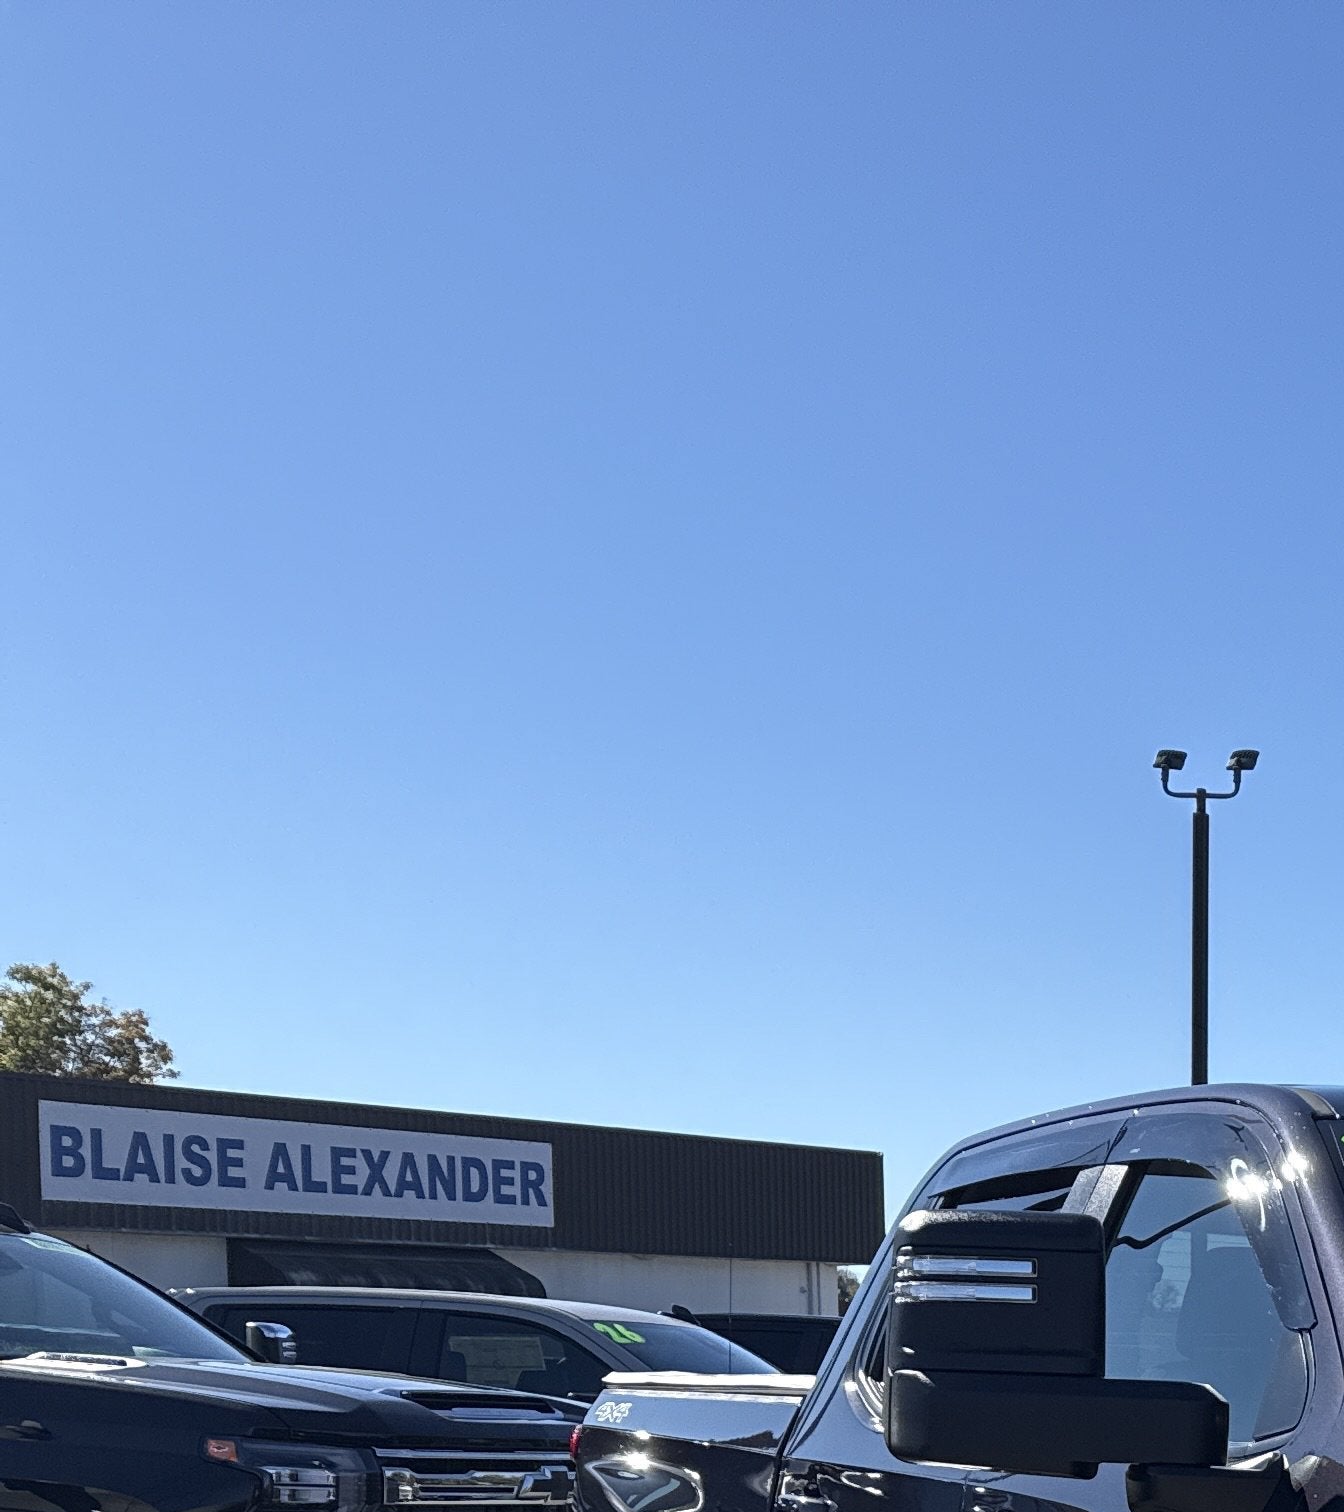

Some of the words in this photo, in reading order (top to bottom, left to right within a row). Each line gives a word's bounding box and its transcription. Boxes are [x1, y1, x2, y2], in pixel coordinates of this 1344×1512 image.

[49, 1124, 247, 1189] BLAISE
[263, 1141, 548, 1207] ALEXANDER
[593, 1322, 646, 1344] 26
